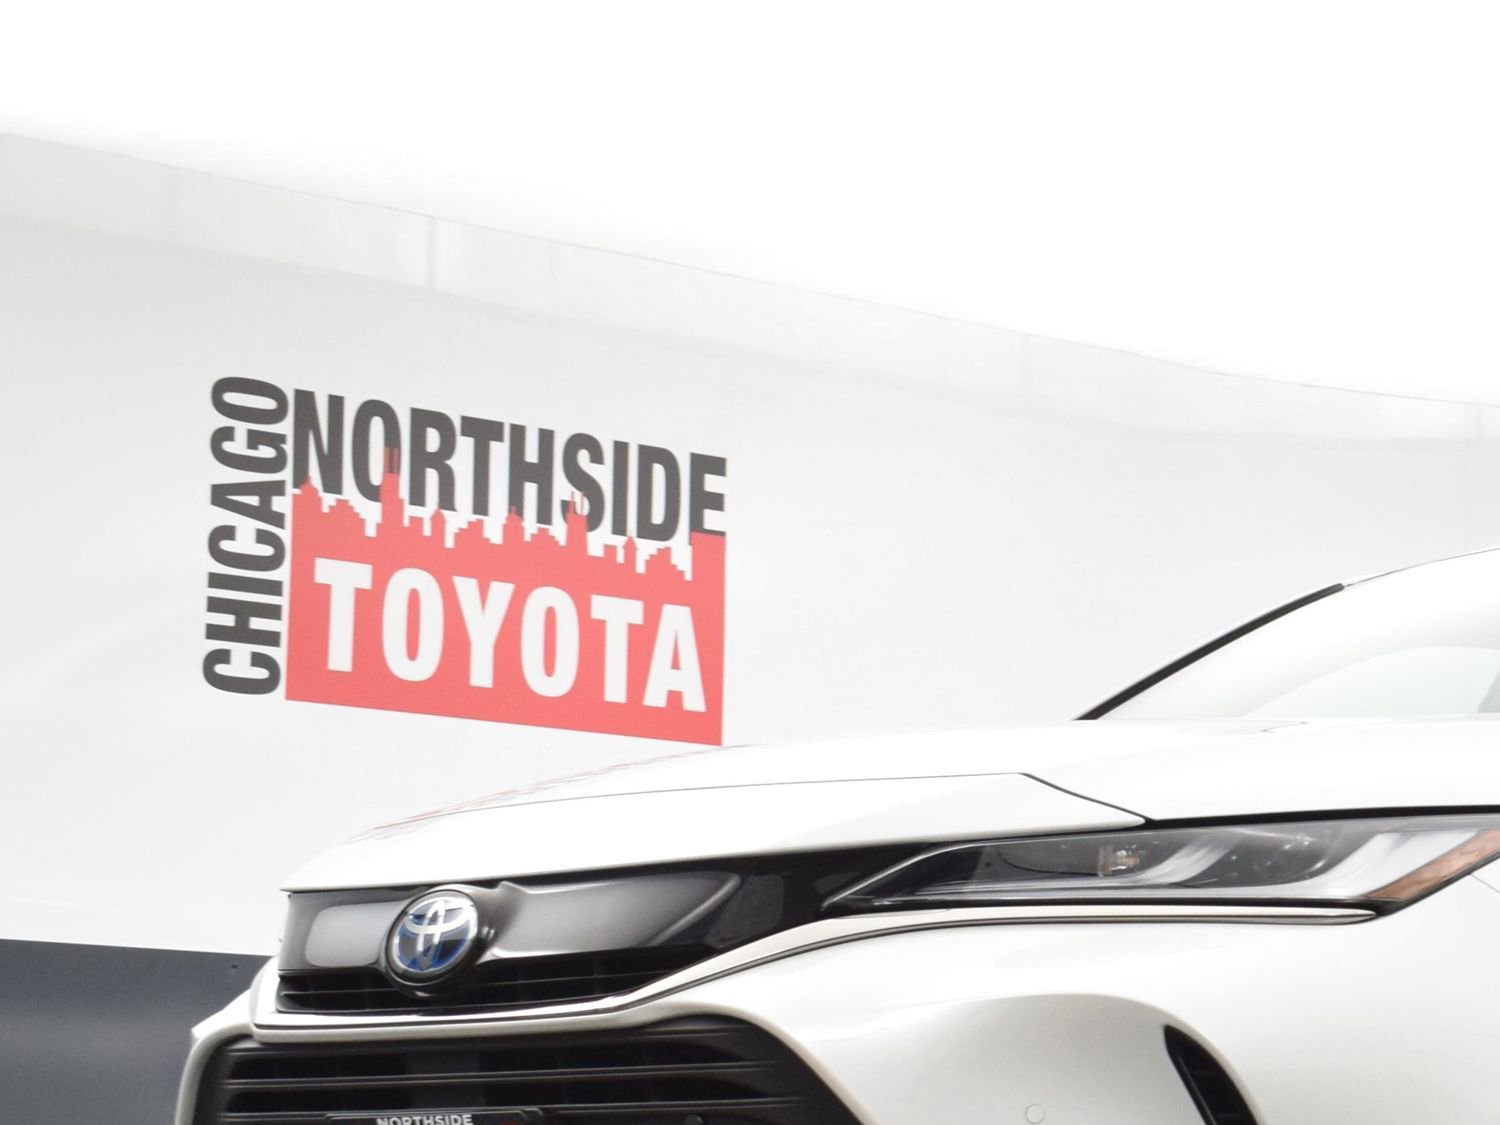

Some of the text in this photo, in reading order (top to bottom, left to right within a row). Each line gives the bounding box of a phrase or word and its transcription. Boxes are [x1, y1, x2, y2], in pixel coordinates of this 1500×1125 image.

[202, 376, 289, 695] CHICAGO
[292, 388, 727, 546] NORTHSIDE
[313, 557, 707, 712] TOYOTA
